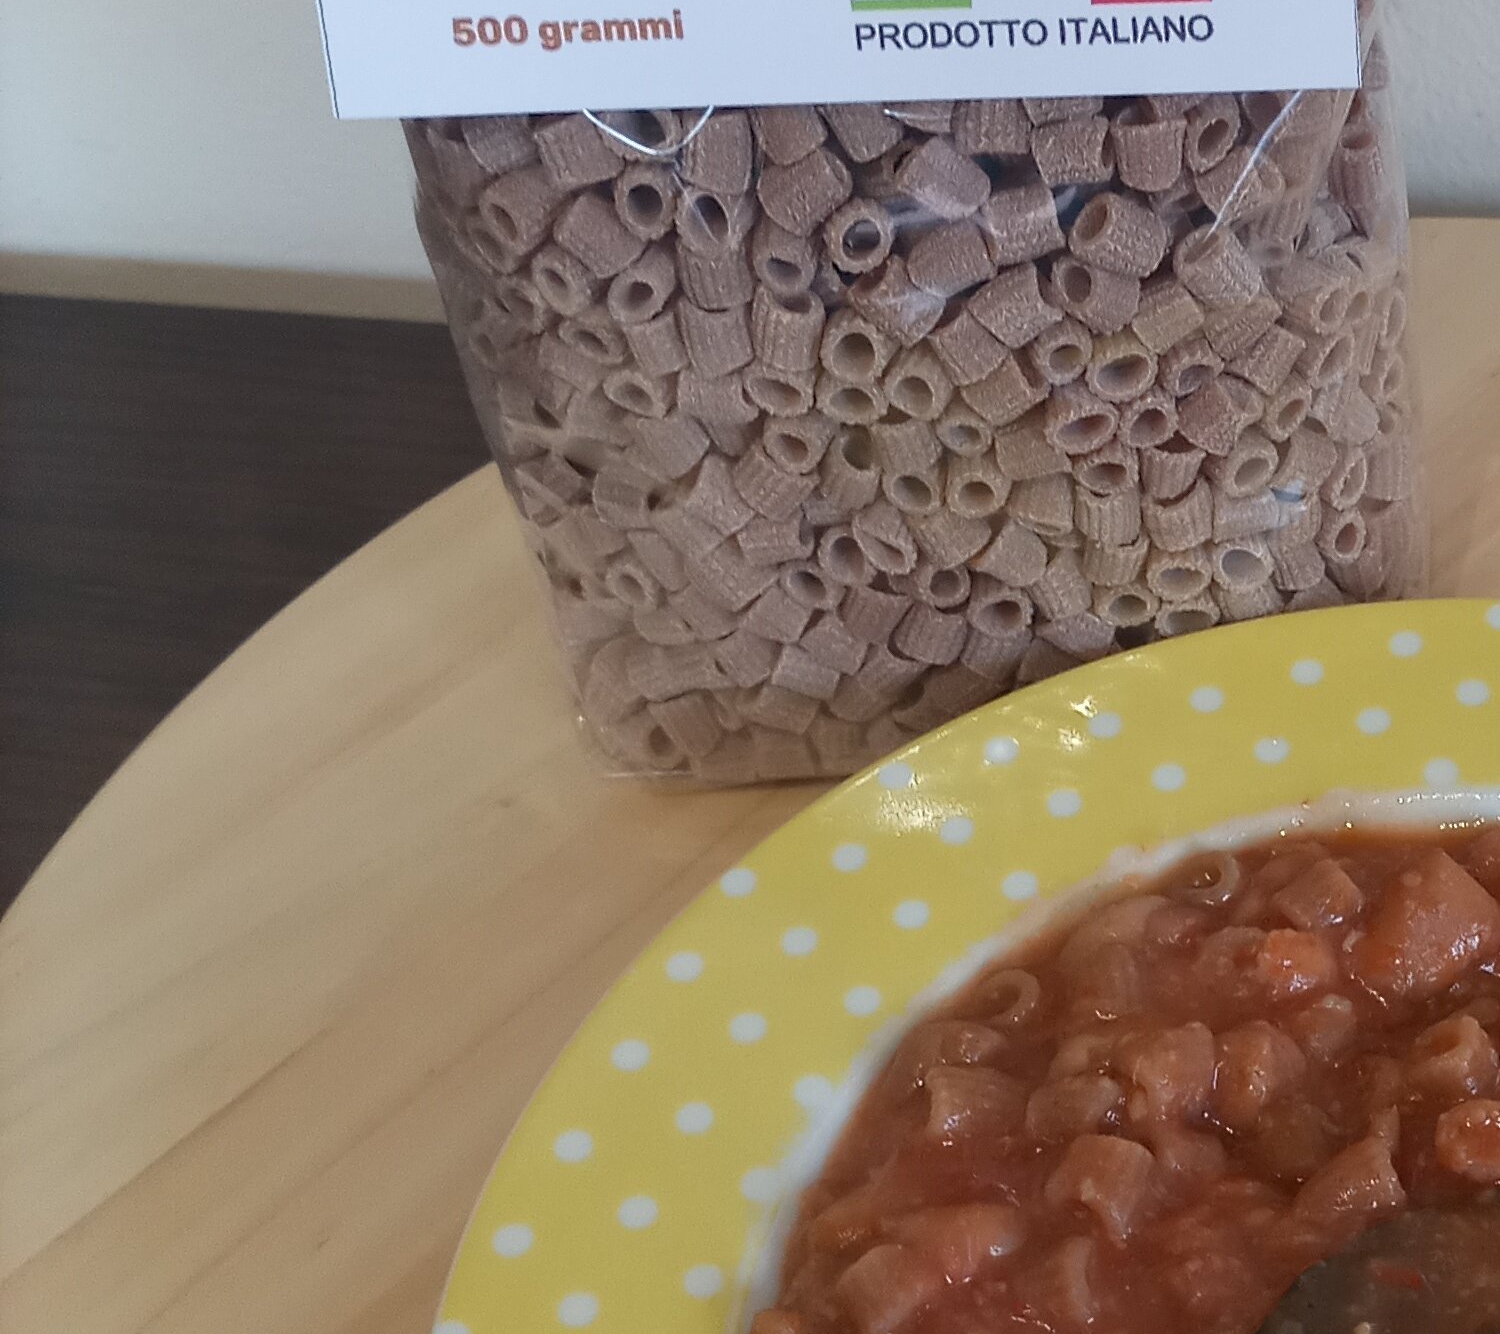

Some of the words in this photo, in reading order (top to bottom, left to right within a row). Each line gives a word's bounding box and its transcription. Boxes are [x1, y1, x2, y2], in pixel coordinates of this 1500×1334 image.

[452, 15, 528, 47] 500
[539, 9, 684, 51] grammi
[855, 18, 1048, 51] PRODOTTO
[1059, 14, 1214, 46] ITALIANO
